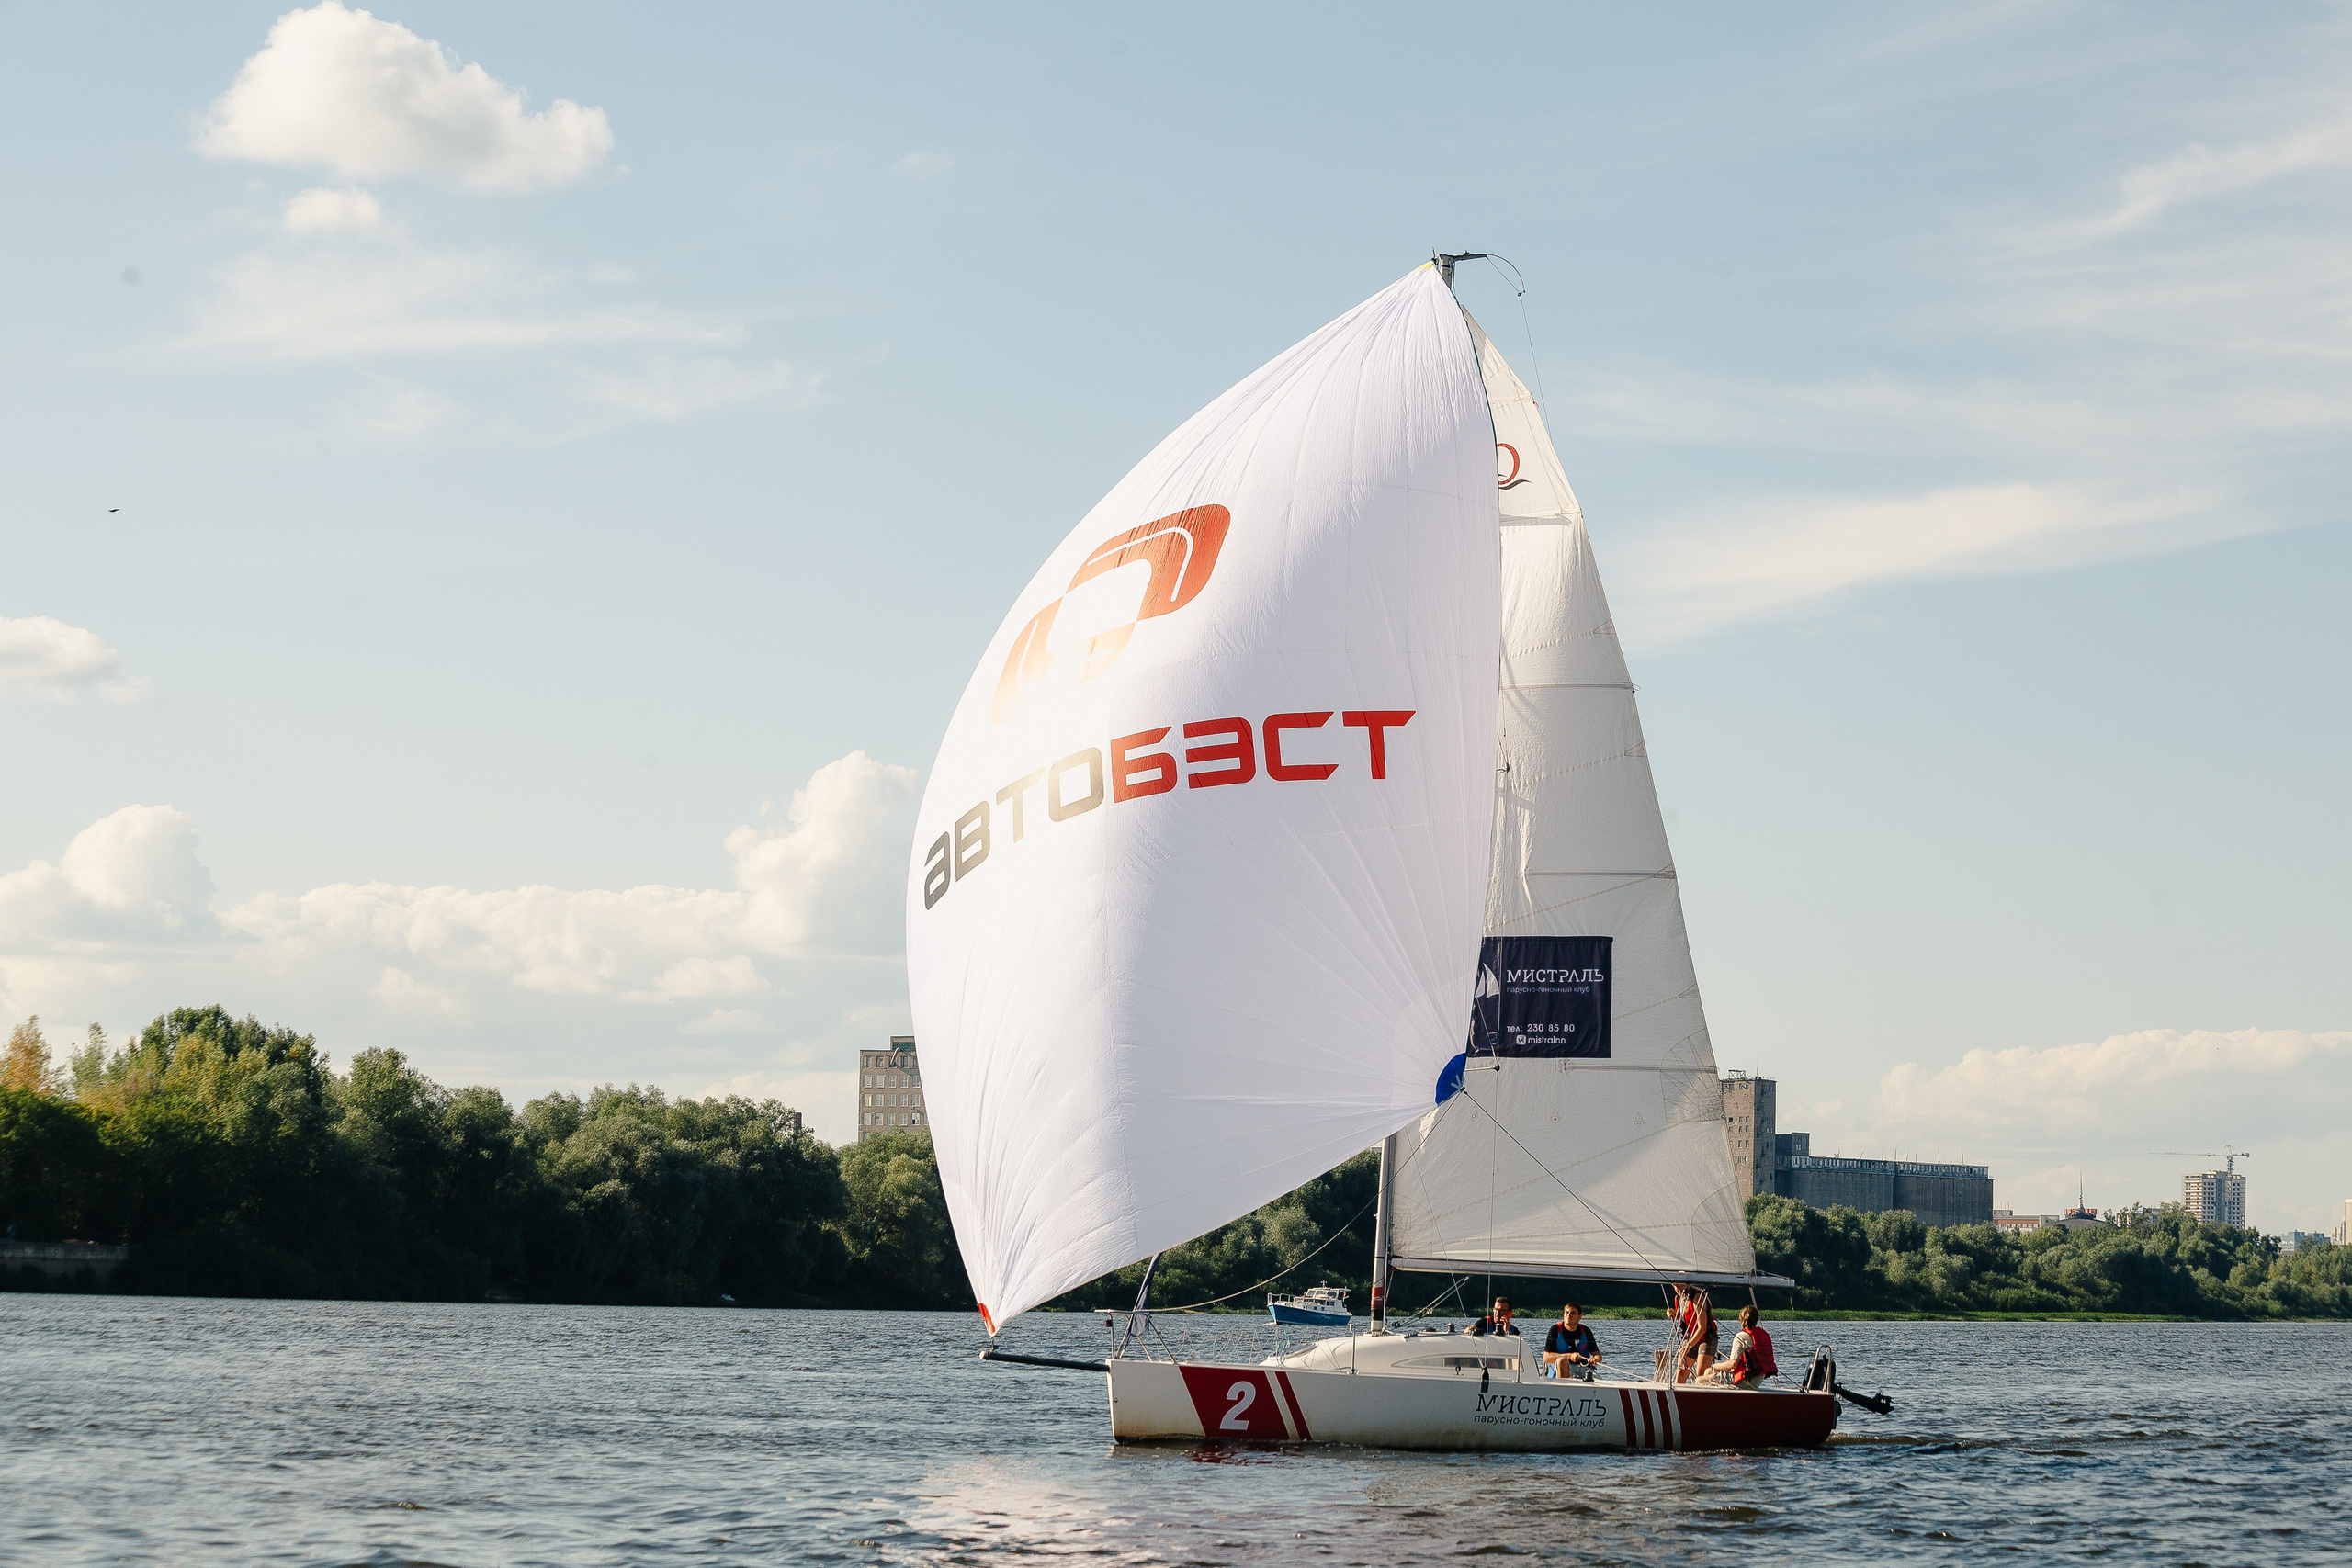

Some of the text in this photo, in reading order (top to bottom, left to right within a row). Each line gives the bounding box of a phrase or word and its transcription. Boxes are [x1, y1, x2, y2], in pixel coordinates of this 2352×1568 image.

[1507, 969, 1604, 983] МИСТРАЛЬ
[1574, 986, 1590, 994] клуб
[1527, 1023, 1544, 1032] 230
[1548, 1023, 1560, 1032] 85
[1564, 1023, 1576, 1032] 80
[1528, 1035, 1566, 1044] mistralnn
[1220, 1381, 1256, 1430] 2
[1476, 1393, 1607, 1417] МИСТРАЛЬ
[1474, 1415, 1606, 1429] парусно-гоночный клуб
